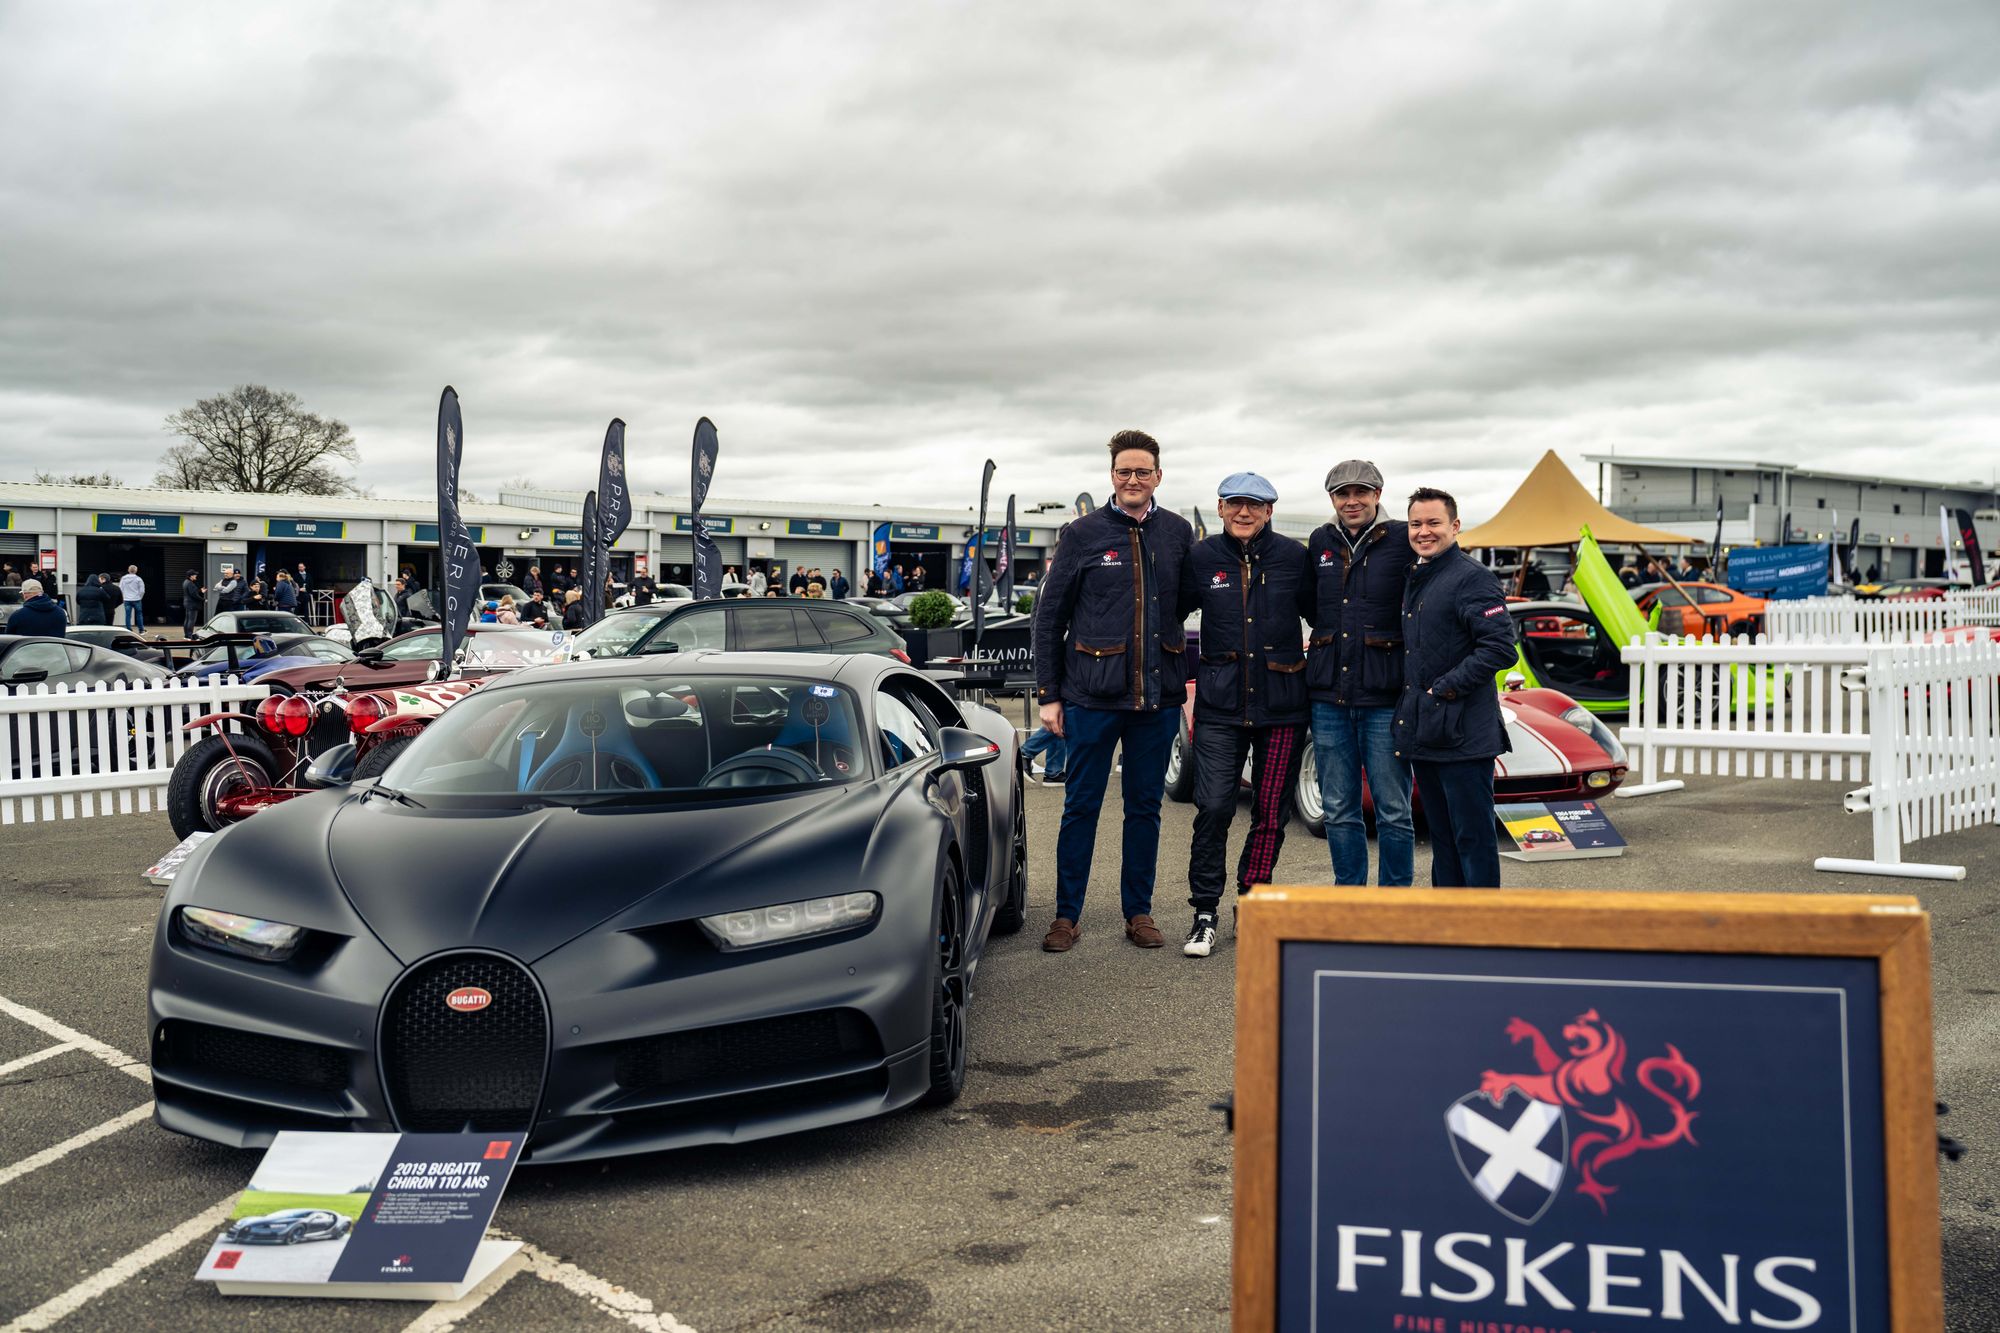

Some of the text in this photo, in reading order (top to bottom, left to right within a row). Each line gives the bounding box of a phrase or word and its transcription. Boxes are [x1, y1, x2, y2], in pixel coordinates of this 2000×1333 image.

[122, 518, 156, 527] AMALGAM
[295, 524, 317, 532] ATTIVO
[1778, 565, 1805, 577] MODERN
[451, 995, 486, 1005] BUGATTI
[393, 1162, 482, 1176] 2019 BUGATTI
[387, 1175, 490, 1190] CHIRON 110 ANS
[1336, 1224, 1822, 1331] FISKENS
[1393, 1314, 1447, 1333] FINE
